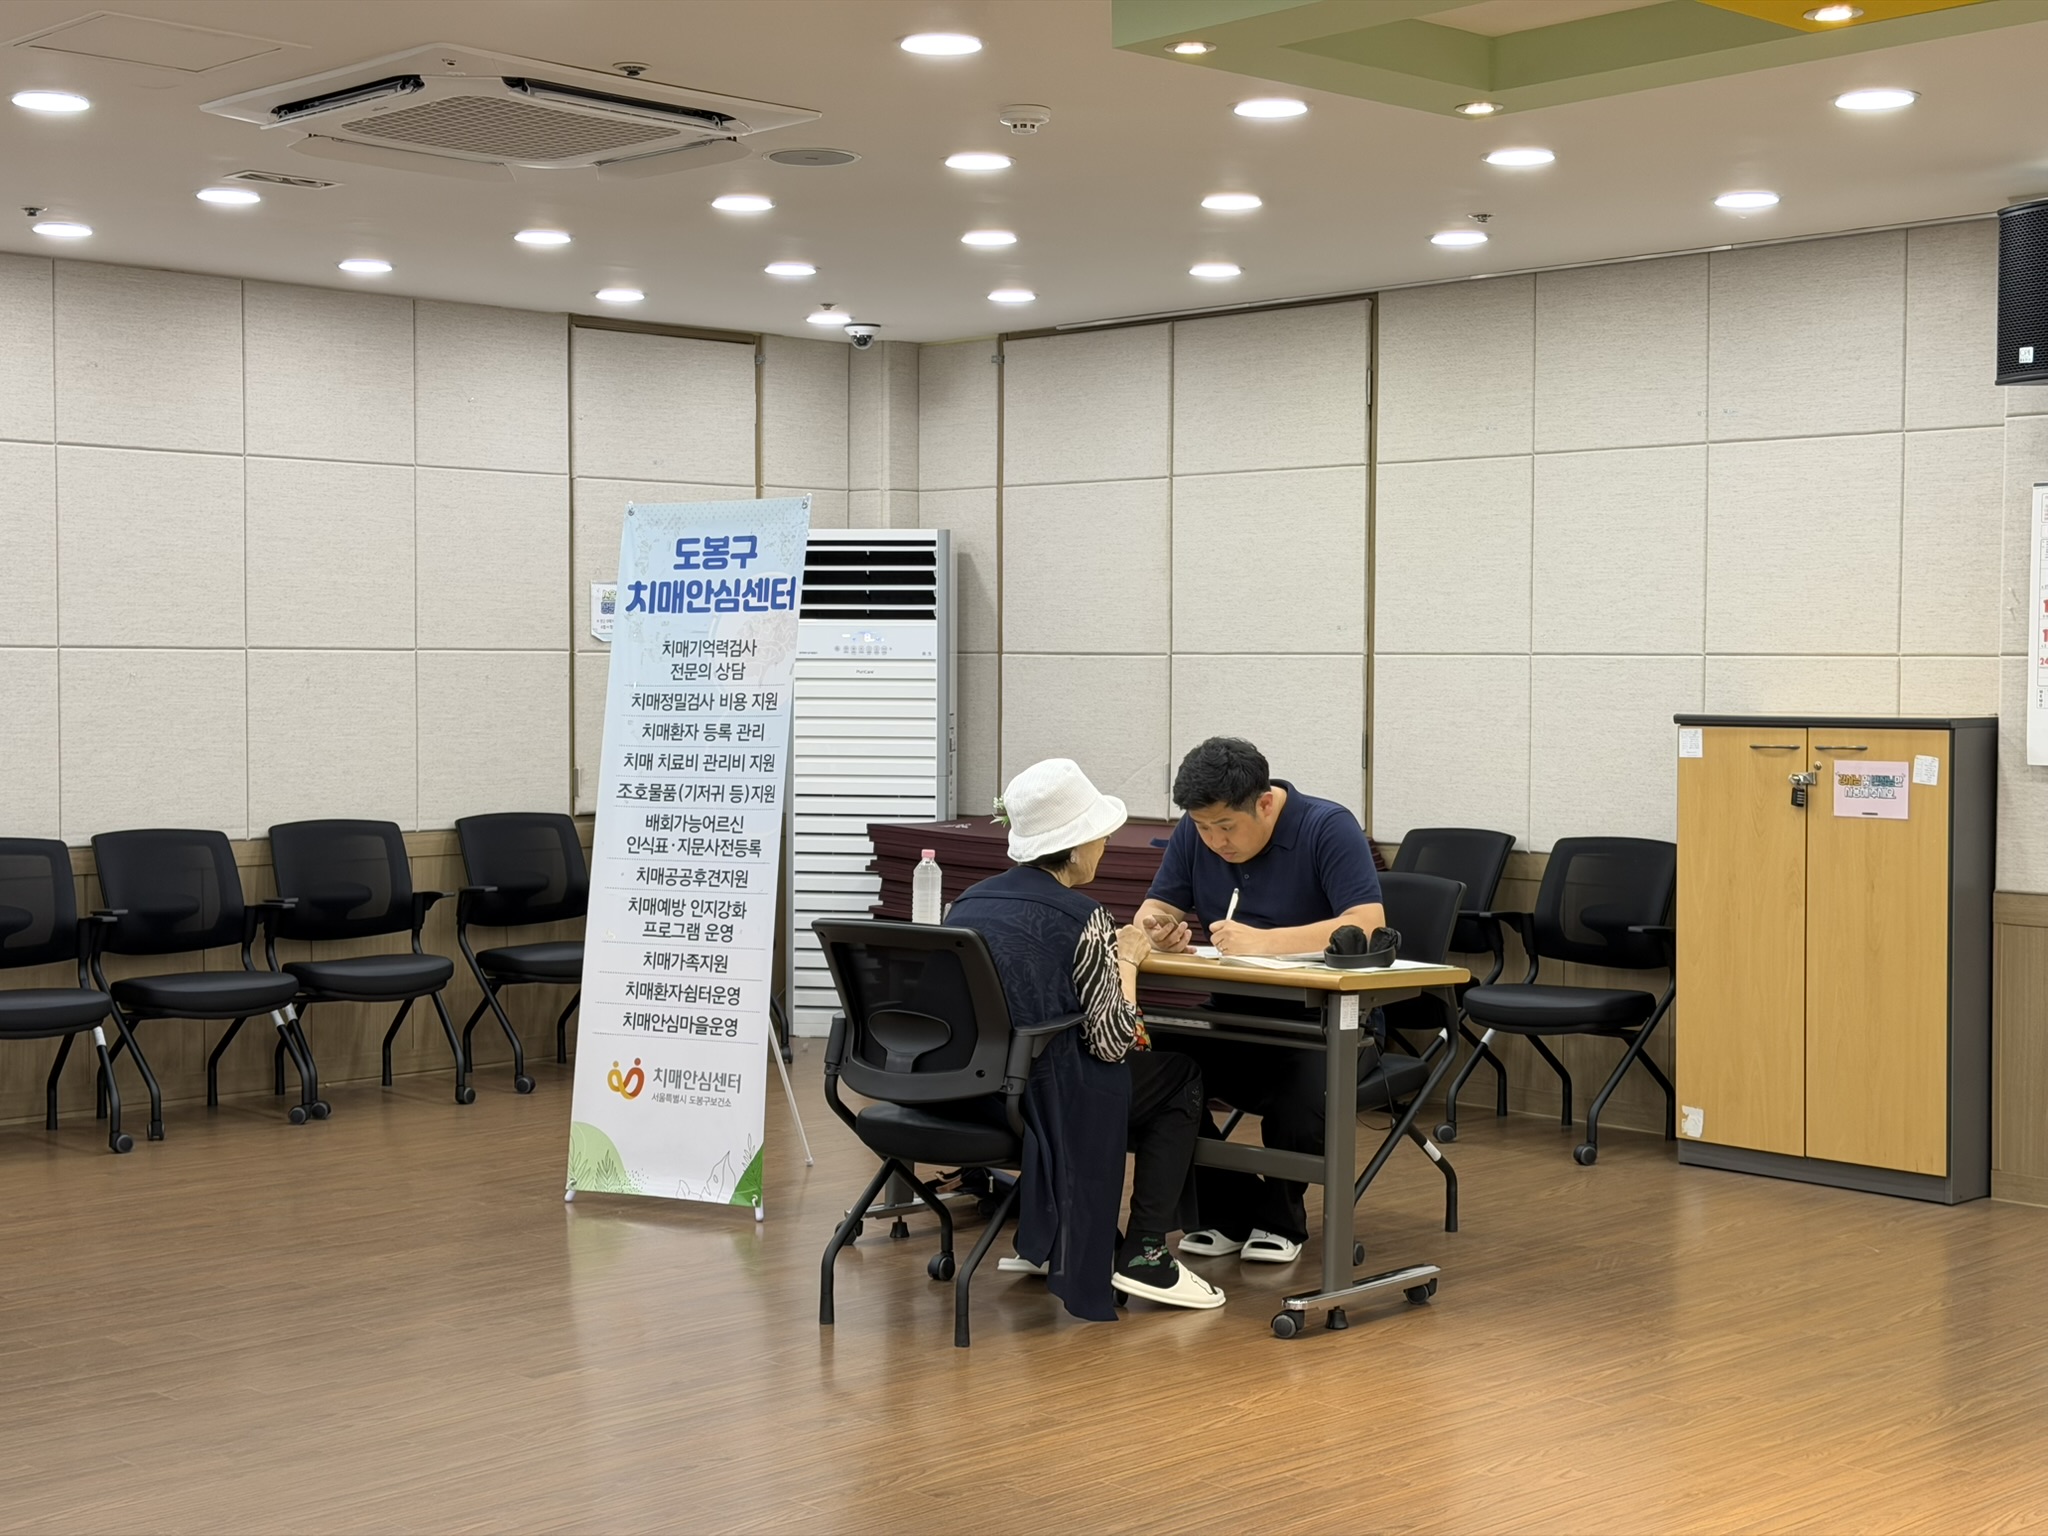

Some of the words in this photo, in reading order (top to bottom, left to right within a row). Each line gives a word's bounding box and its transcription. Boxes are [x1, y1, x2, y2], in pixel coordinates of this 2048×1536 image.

[673, 535, 758, 570] 도봉구
[625, 576, 797, 614] 치매안심센터
[662, 639, 757, 657] 치매기억력검사
[670, 662, 712, 681] 전문의
[715, 662, 746, 681] 상담
[631, 692, 715, 711] 치매정밀검사
[719, 692, 747, 711] 비용
[751, 692, 778, 711] 지원
[641, 722, 700, 742] 치매환자
[703, 723, 732, 741] 등록
[736, 722, 765, 742] 관리
[623, 752, 654, 771] 치매
[657, 753, 699, 772] 치료비
[702, 753, 745, 772] 관리비
[749, 753, 775, 772] 지원
[645, 814, 744, 834] 배회가능어르신
[636, 867, 749, 888] 치매공공후견지원
[627, 896, 687, 917] 치매예방
[690, 900, 747, 920] 인지강화
[642, 922, 700, 942] 프로그램
[704, 923, 734, 943] 운영
[642, 951, 728, 974] 치매가족지원
[625, 981, 741, 1006] 치매환자쉼터운영
[622, 1011, 739, 1037] 치매안심마을운영
[652, 1067, 742, 1094] 치매안심센터
[651, 1092, 687, 1105] 서울특별시
[689, 1095, 732, 1108] 도봉구보건소
